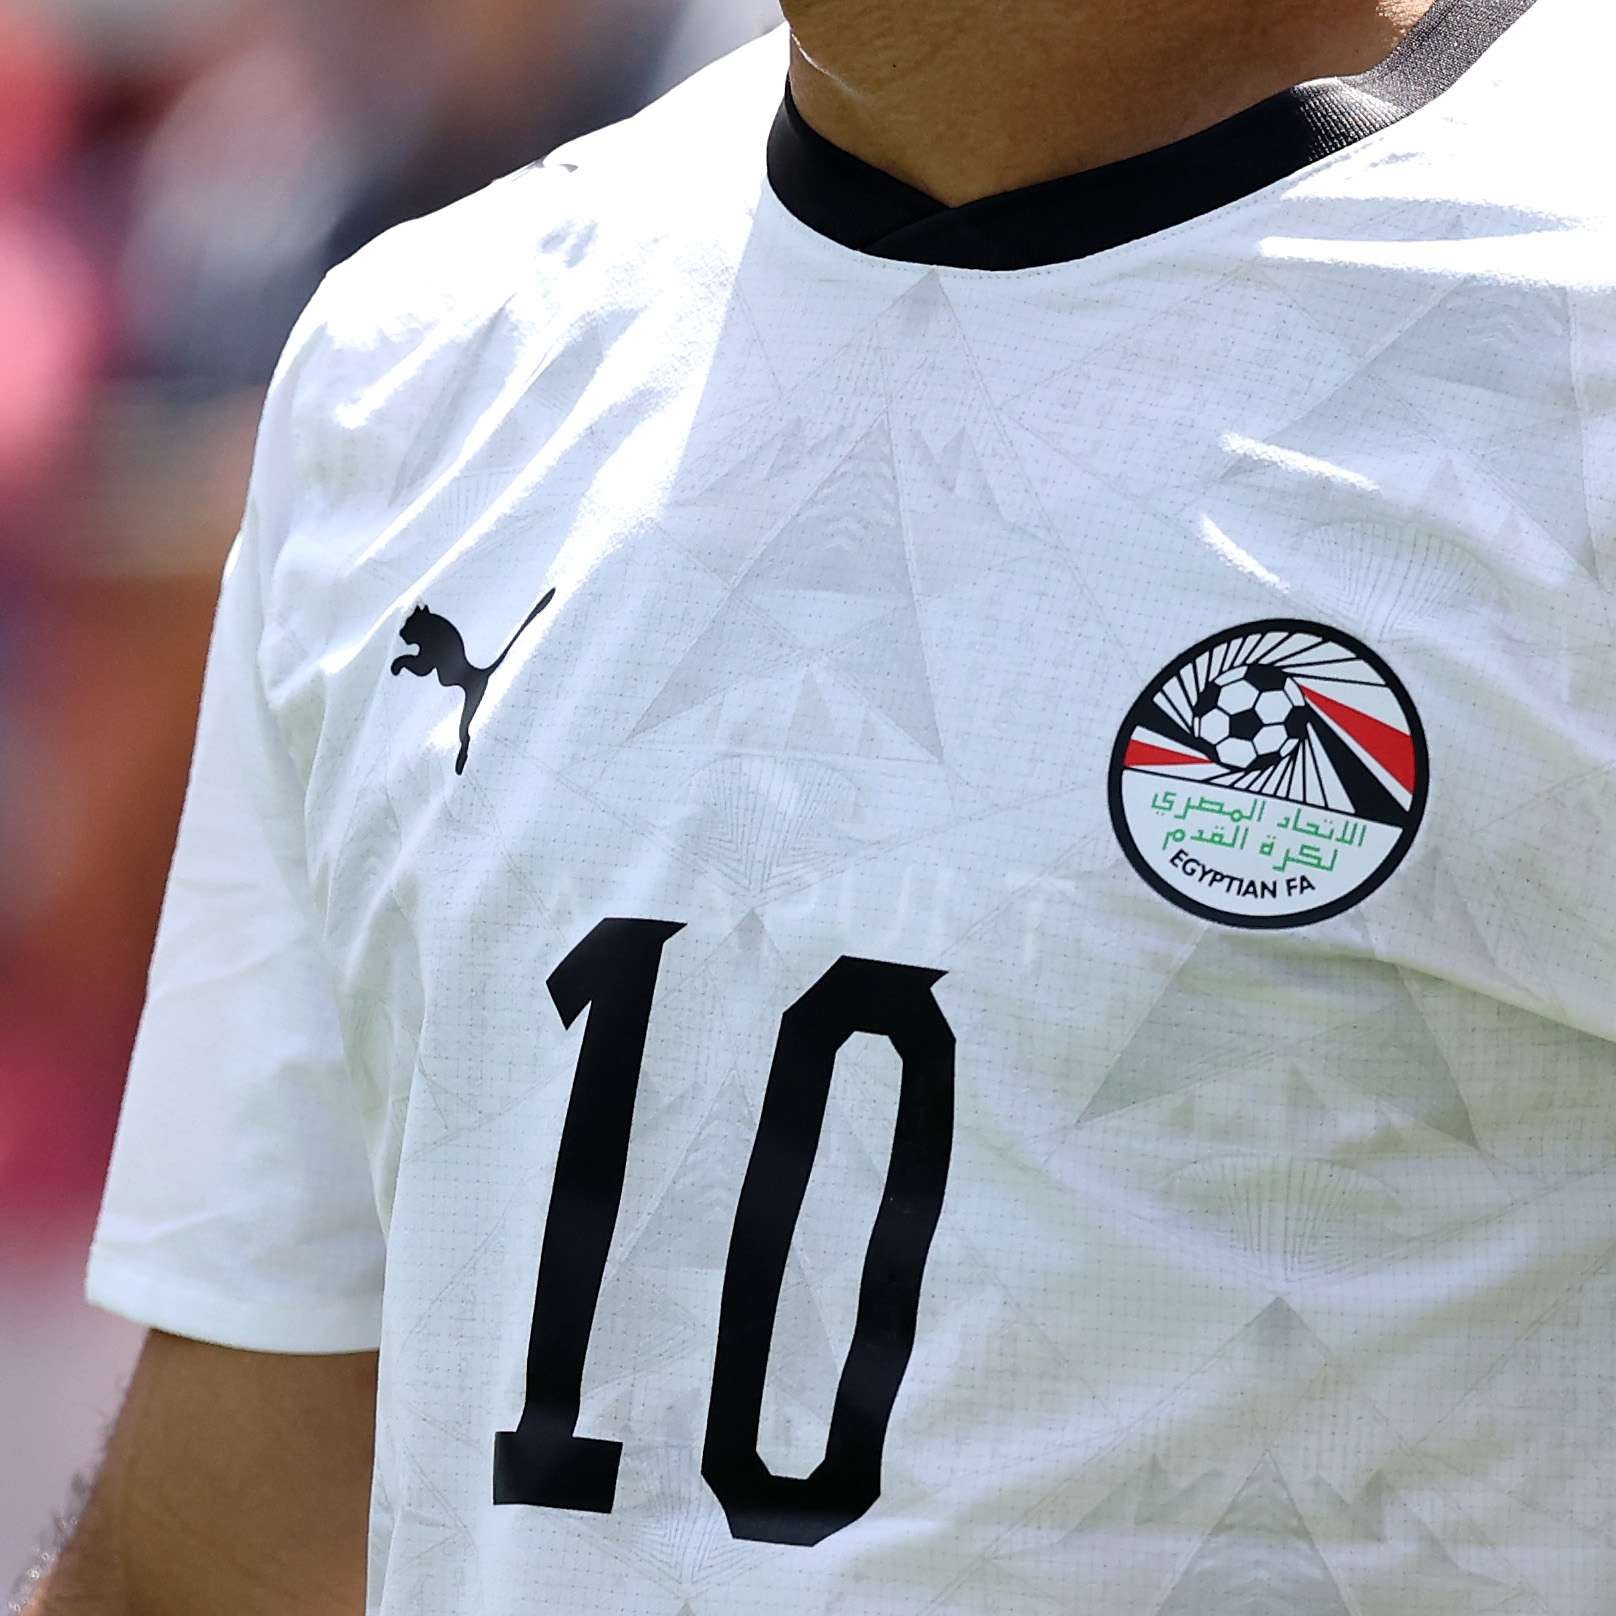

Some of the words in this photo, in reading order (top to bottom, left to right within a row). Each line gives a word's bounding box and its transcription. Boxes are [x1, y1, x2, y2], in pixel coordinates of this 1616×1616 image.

[1150, 790, 1267, 823] المصري
[1161, 824, 1250, 851] القدم
[1276, 807, 1367, 847] الاتحاد
[1257, 833, 1339, 873] لكرة
[1169, 848, 1278, 899] EGYPTIAN
[1285, 874, 1316, 897] FA
[492, 917, 957, 1547] 10
